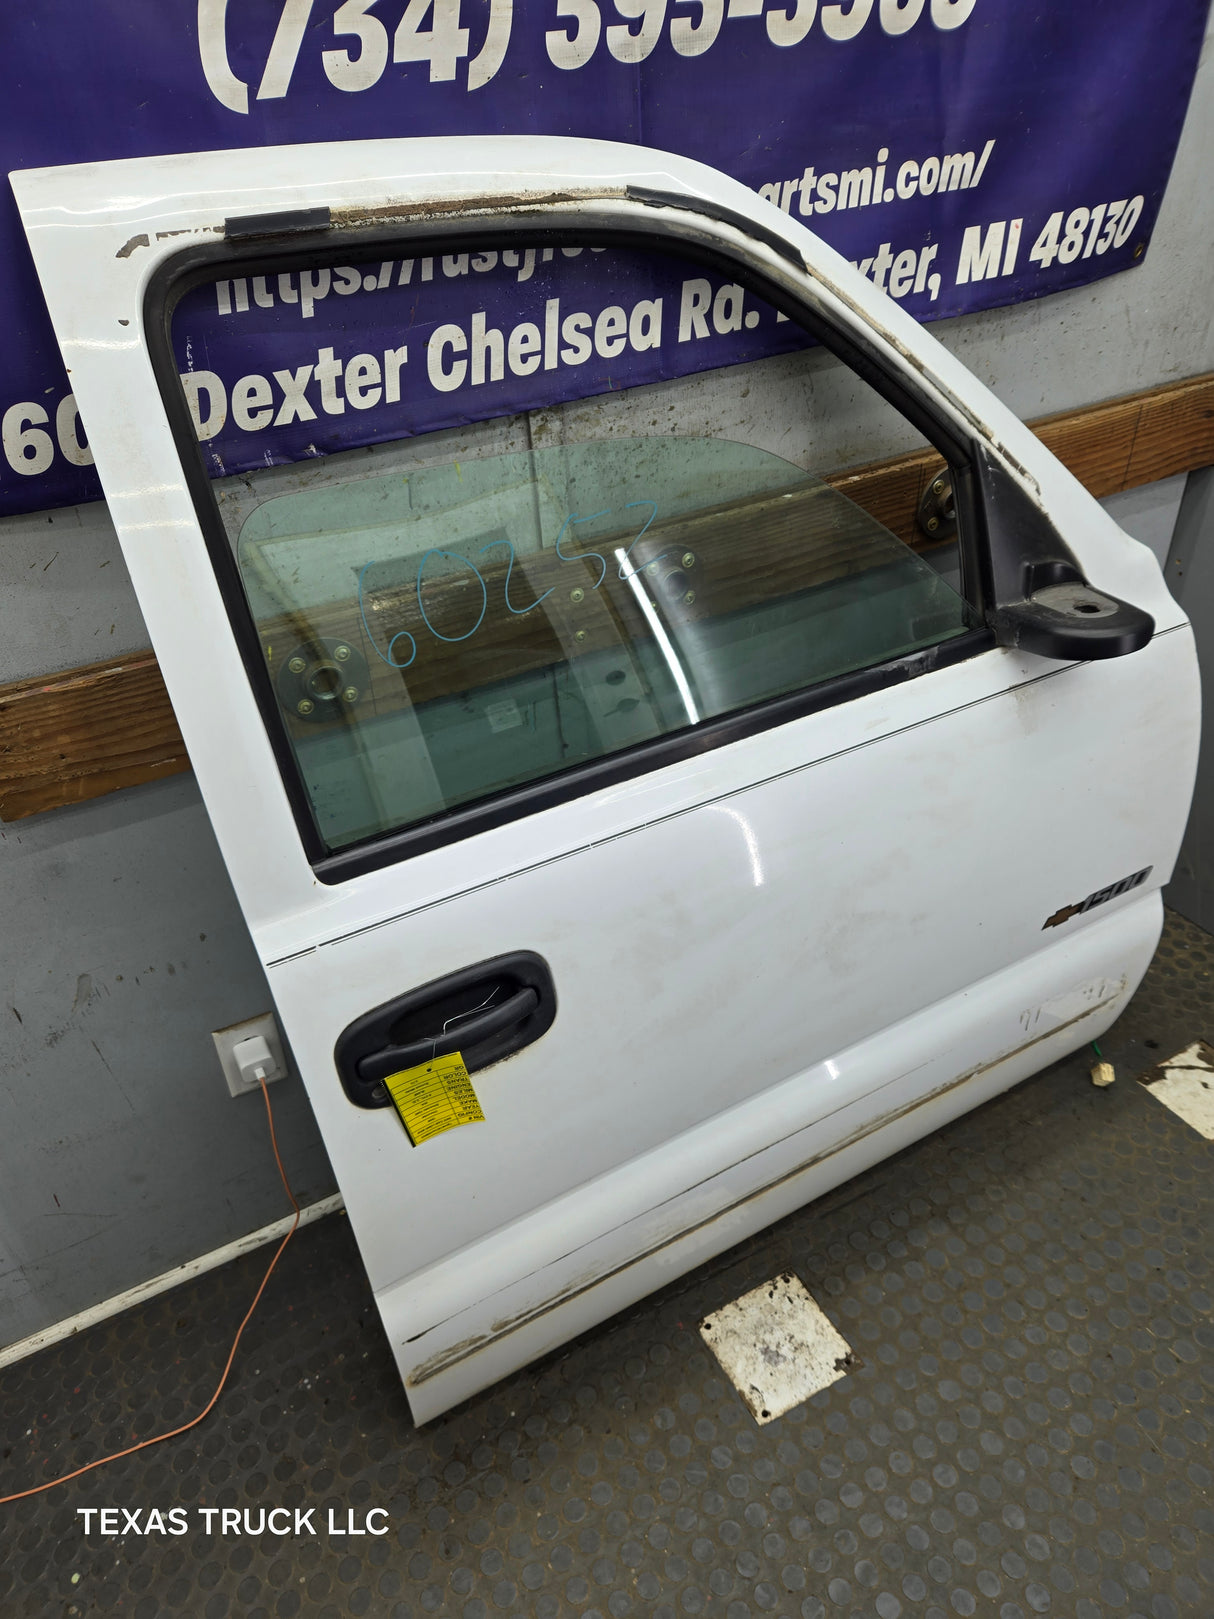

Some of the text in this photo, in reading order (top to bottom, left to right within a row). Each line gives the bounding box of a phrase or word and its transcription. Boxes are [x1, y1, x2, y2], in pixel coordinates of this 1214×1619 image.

[179, 345, 407, 441] Dexter
[426, 298, 663, 392] Chelsea
[955, 218, 1023, 285] MI
[1029, 195, 1144, 269] 48130
[1079, 865, 1153, 914] 1500
